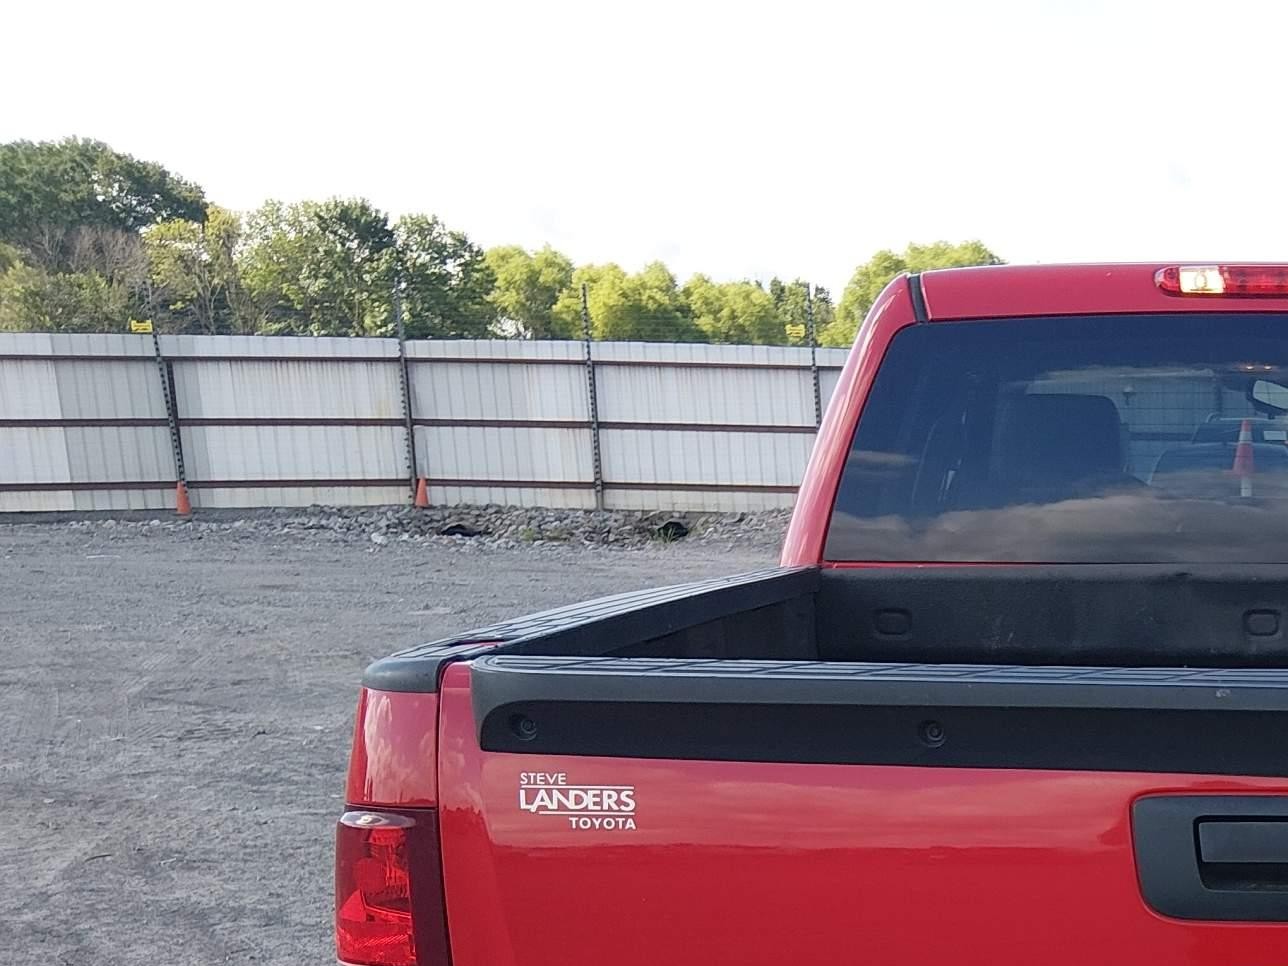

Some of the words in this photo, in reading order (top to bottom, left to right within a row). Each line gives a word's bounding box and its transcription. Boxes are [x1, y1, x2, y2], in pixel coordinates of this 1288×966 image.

[520, 772, 567, 785] STEVE
[519, 789, 636, 813] LANDERS
[569, 817, 637, 830] TOYOTA
